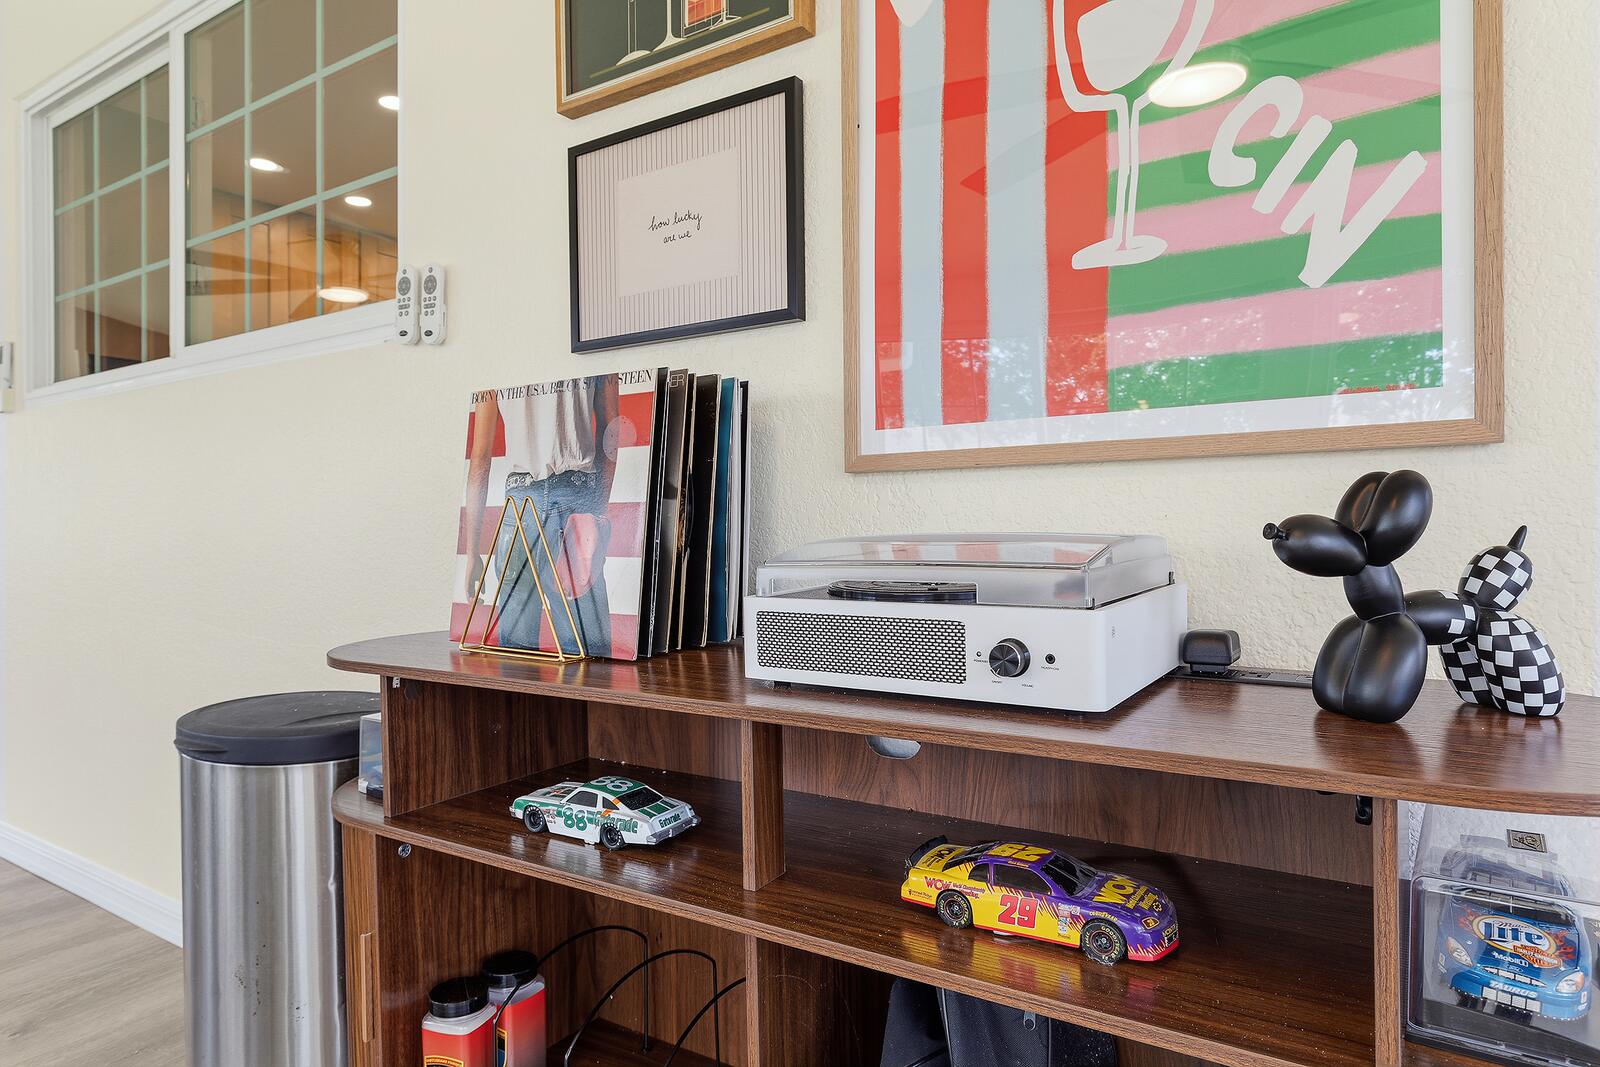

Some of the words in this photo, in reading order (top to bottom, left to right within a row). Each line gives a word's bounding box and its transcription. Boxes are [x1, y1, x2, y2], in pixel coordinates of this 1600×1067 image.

[1208, 75, 1427, 288] CIN
[648, 215, 670, 231] how
[672, 210, 702, 231] lucky
[663, 234, 677, 244] are
[678, 230, 692, 240] we
[471, 390, 494, 405] BORN
[495, 388, 505, 401] IN
[507, 385, 526, 400] THE
[582, 368, 655, 391] SPNSTEEN
[562, 806, 588, 832] 88
[658, 812, 682, 829] Gatorade
[998, 894, 1039, 930] 29
[1483, 921, 1545, 947] Lite
[1489, 980, 1538, 998] TAURUS
